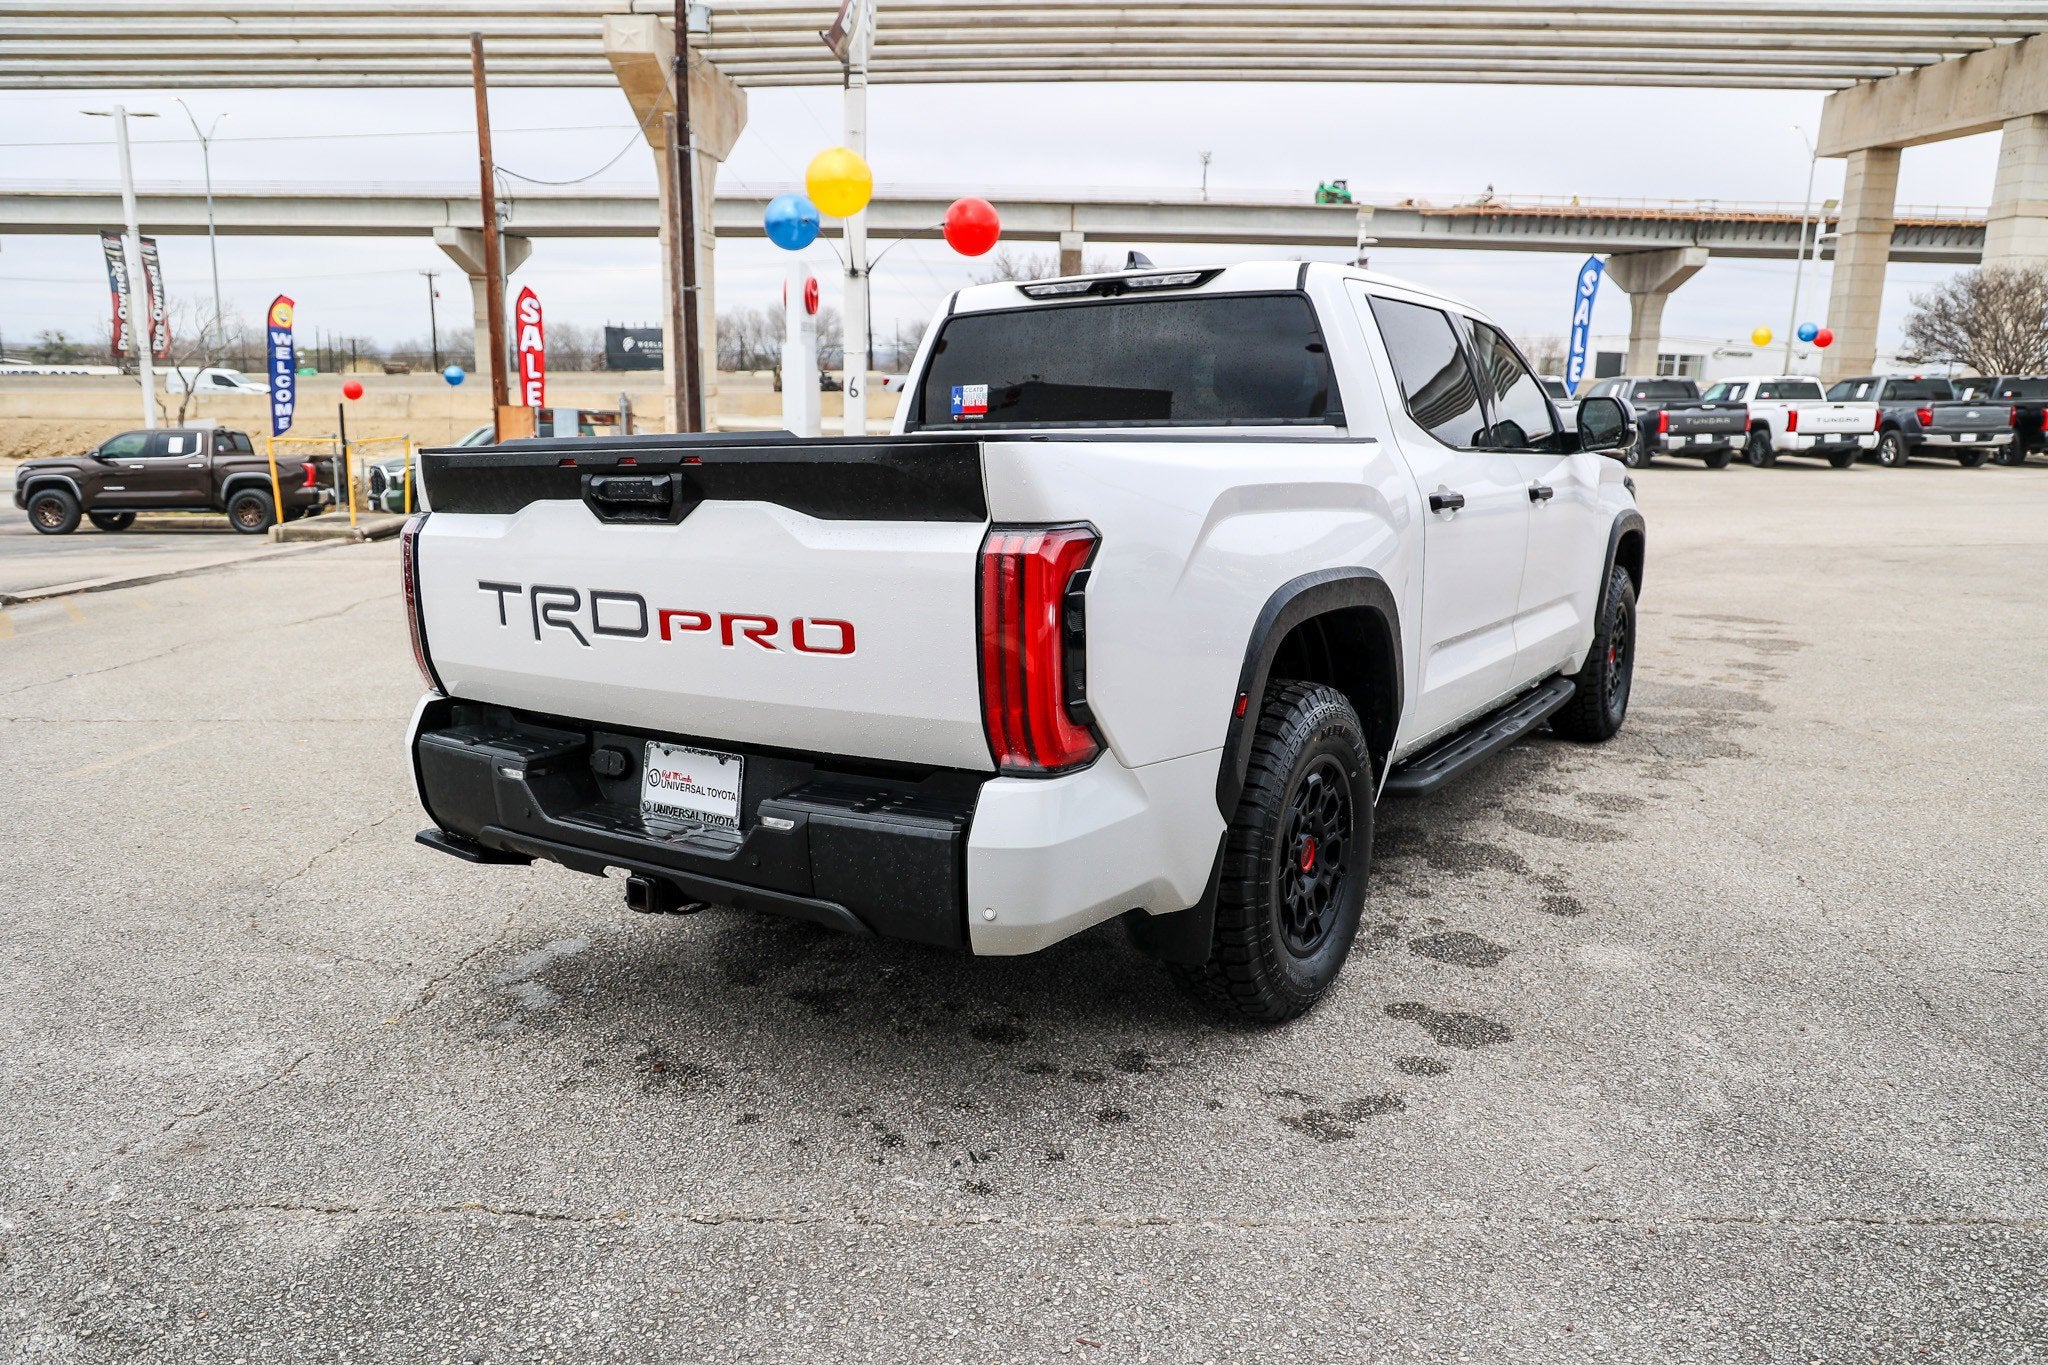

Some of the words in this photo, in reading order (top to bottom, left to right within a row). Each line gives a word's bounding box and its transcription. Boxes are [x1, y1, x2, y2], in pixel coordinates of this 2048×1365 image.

[117, 323, 128, 350] Pre
[153, 324, 165, 350] Pre
[1570, 269, 1598, 382] SALE
[520, 297, 543, 407] SALE
[271, 331, 293, 430] WELCOME
[849, 376, 859, 397] 6
[477, 580, 649, 648] TRD
[658, 608, 856, 656] PRO
[661, 780, 706, 795] UNIVERSAL
[707, 787, 737, 801] TOYOTA
[654, 804, 701, 820] UNIVERSAL
[703, 813, 735, 827] TOYOTA
